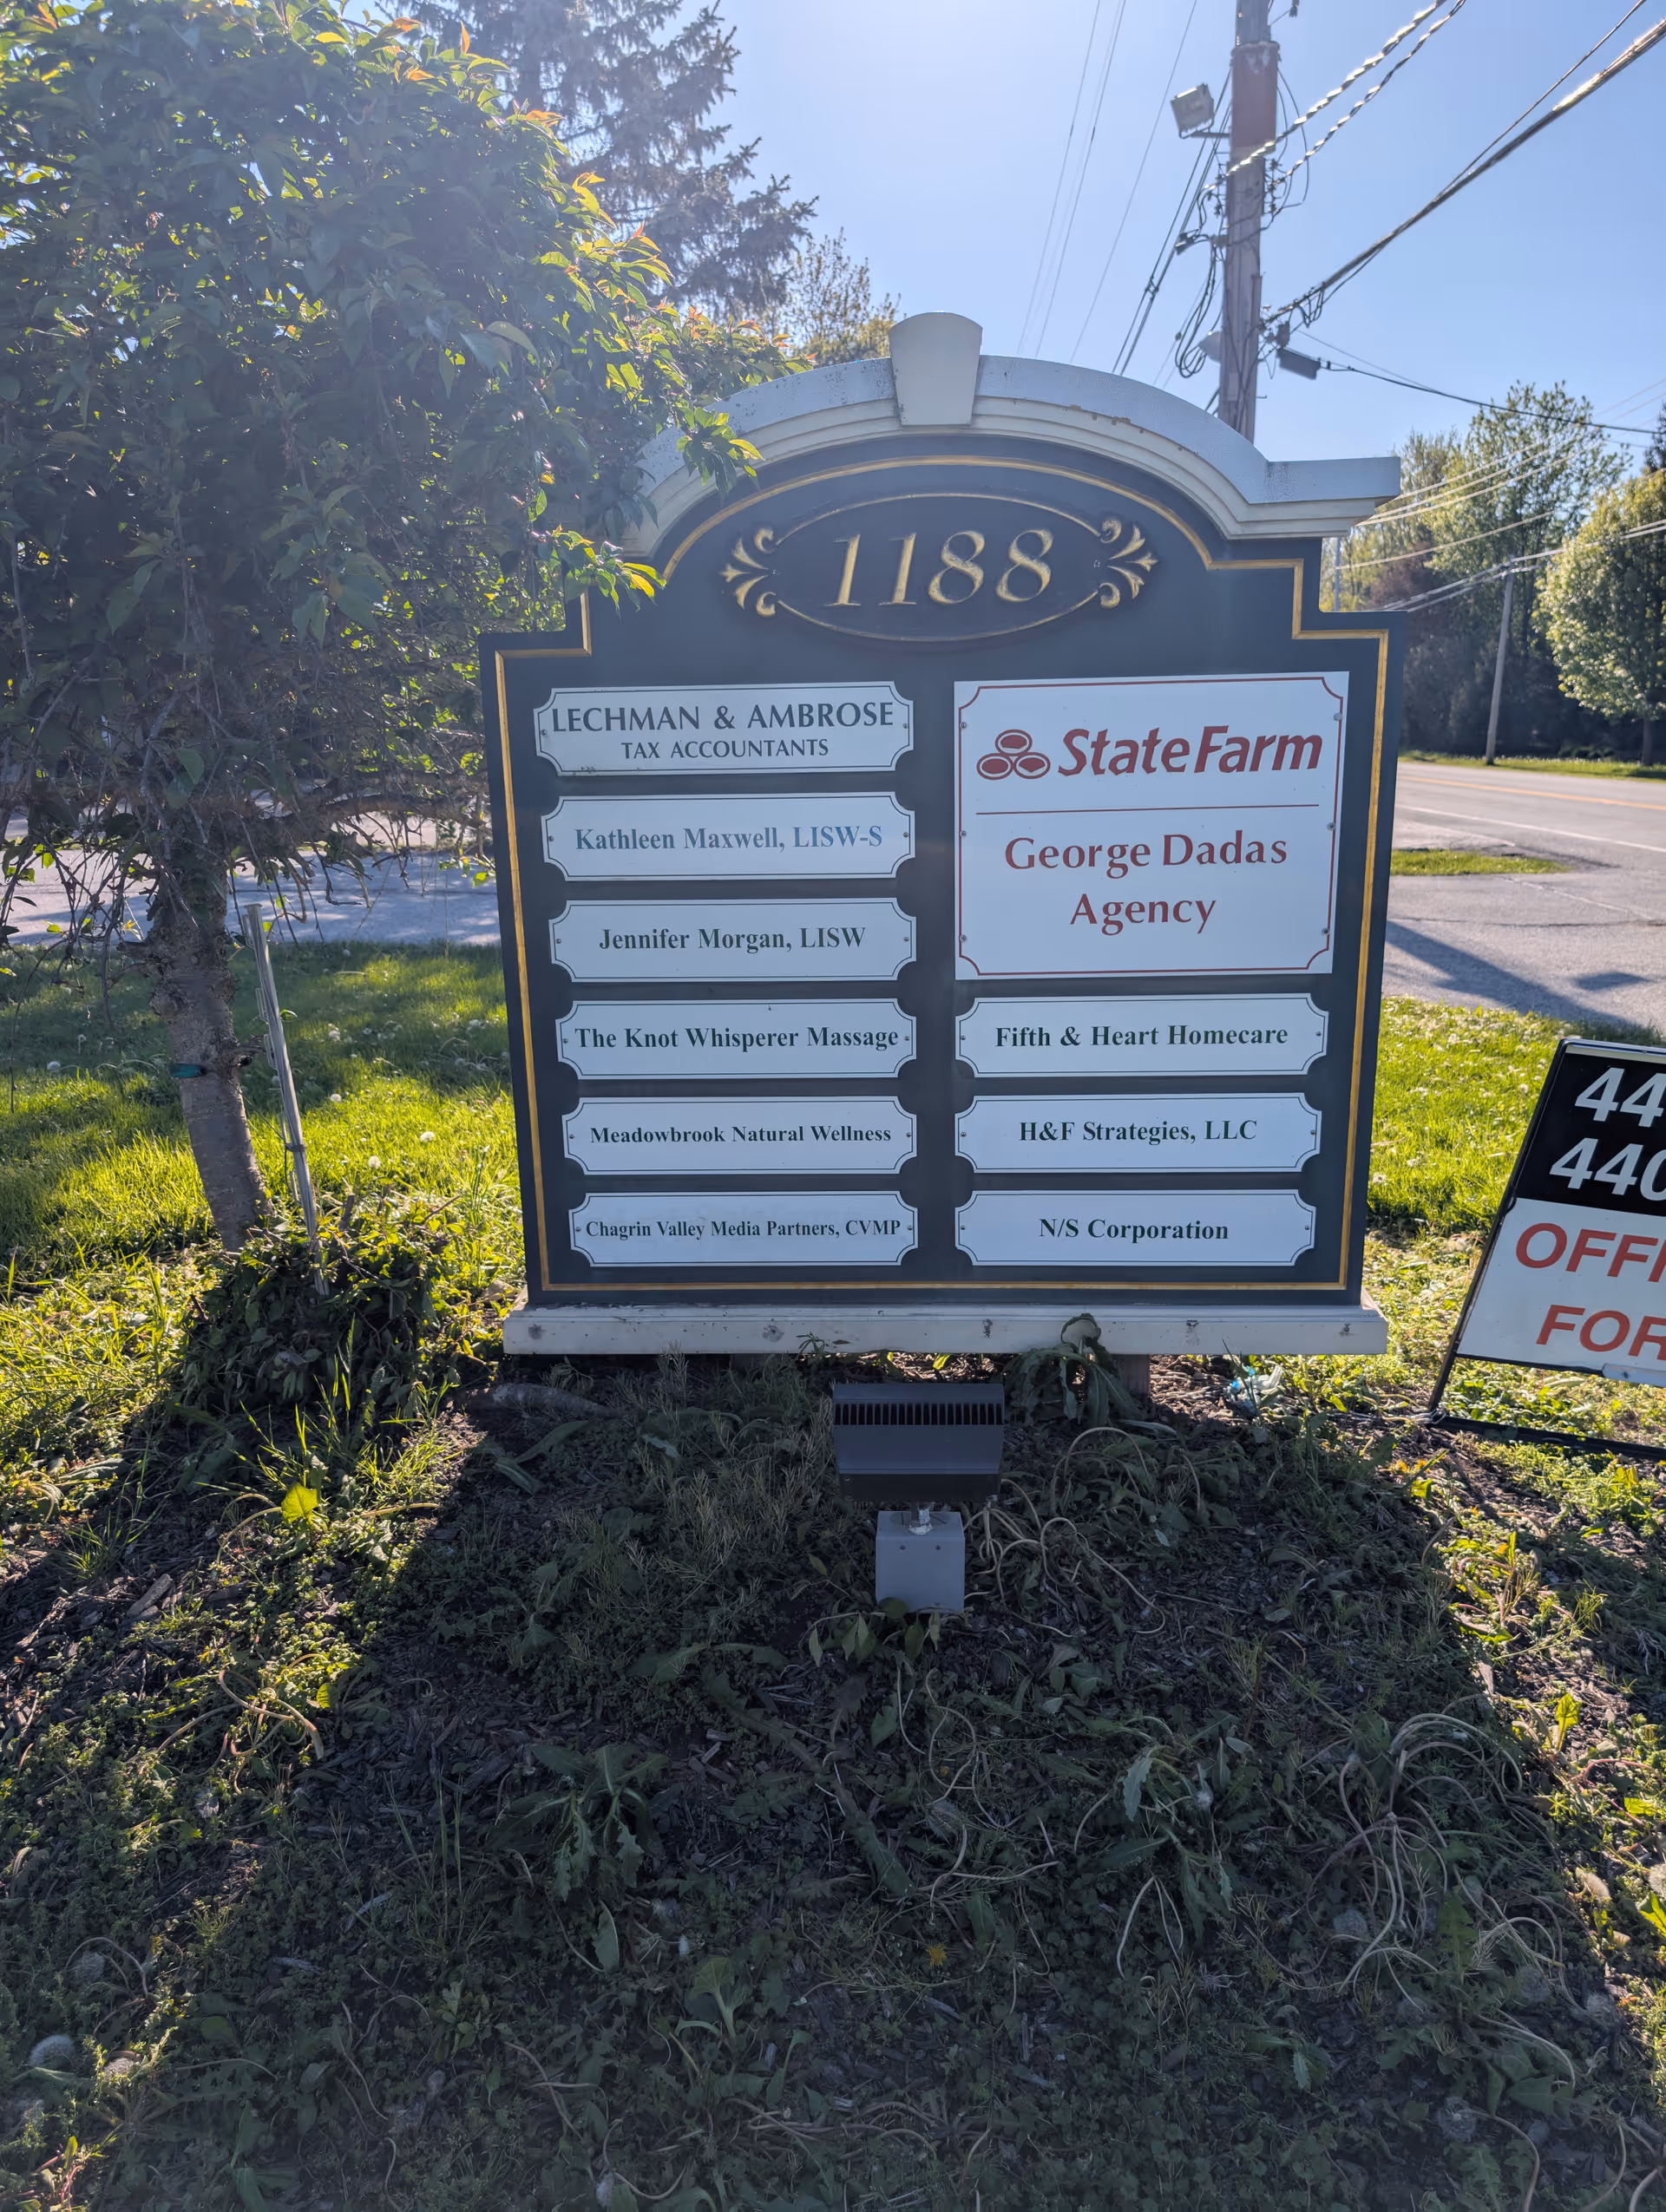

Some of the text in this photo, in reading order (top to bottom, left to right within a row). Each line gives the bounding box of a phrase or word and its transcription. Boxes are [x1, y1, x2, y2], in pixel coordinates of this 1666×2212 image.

[824, 529, 1054, 606] 1188
[552, 700, 895, 733] LECHMAN & AMBROSE
[621, 738, 830, 761] TAX ACCOUNTANTS
[575, 825, 883, 854] Kathleen Maxwell, LISW-S
[1005, 829, 1288, 880] George Dadas
[1069, 893, 1217, 937] Agency
[599, 926, 867, 955] Jennifer Morgan, LISW
[574, 1026, 899, 1053] The Knot Whisperer Massage
[995, 1024, 1289, 1048] Fifth & Heart Homecare
[590, 1124, 892, 1144] Meadowbrook Natural Wellness
[1019, 1119, 1258, 1146] H&F Strategies, LLC
[586, 1219, 902, 1241] Chagrin Valley Media Partners, CVMP
[1039, 1218, 1230, 1244] N/S Corporation
